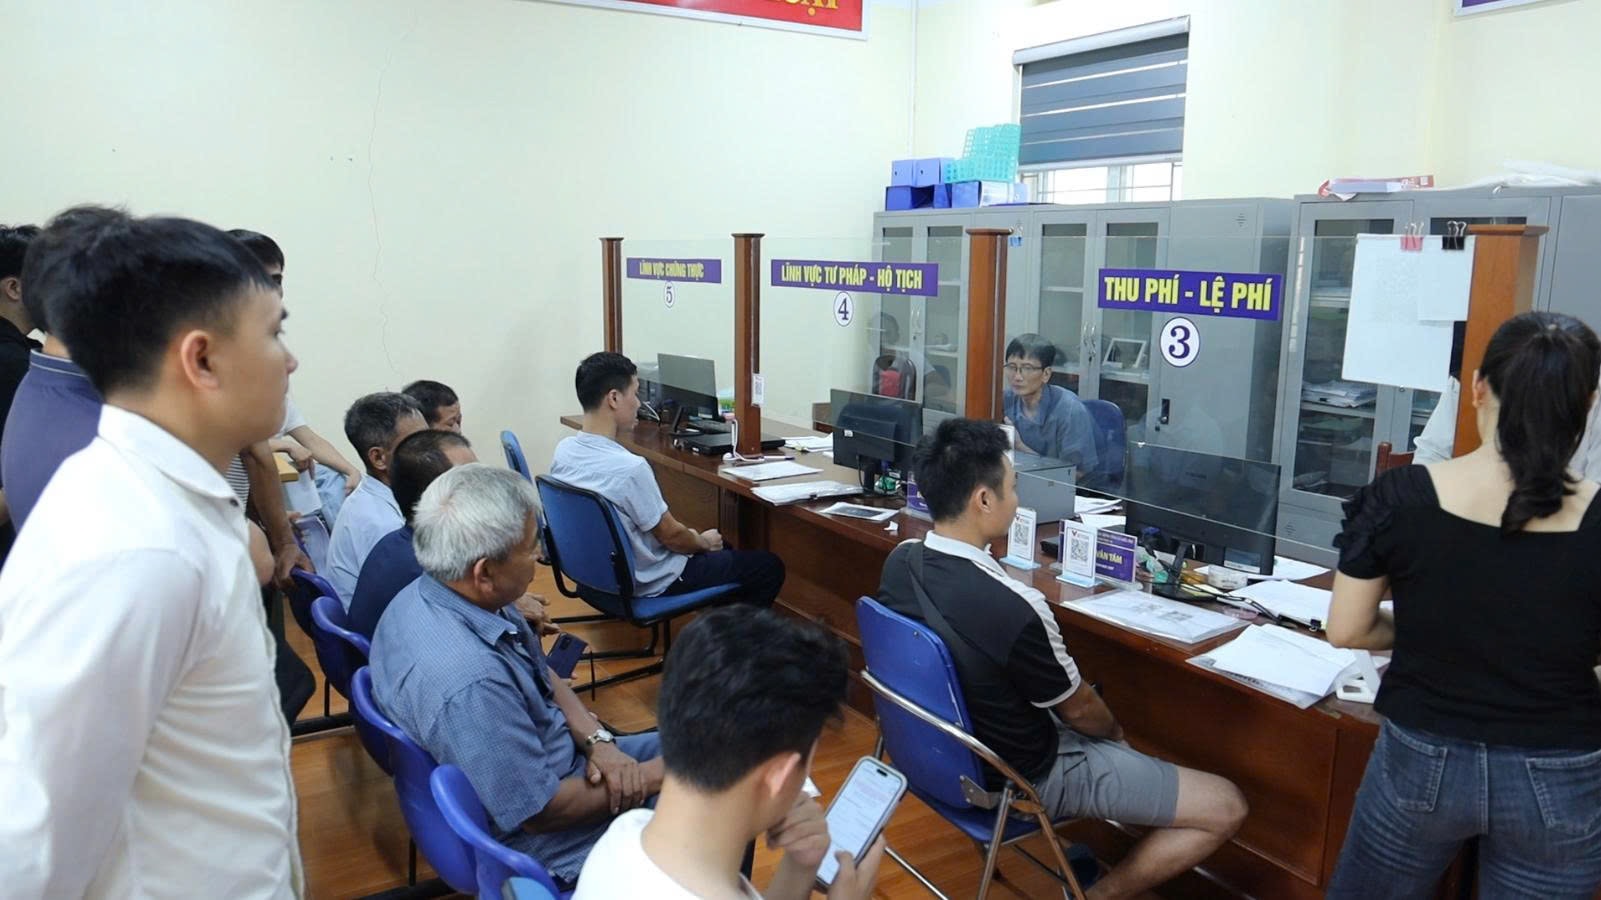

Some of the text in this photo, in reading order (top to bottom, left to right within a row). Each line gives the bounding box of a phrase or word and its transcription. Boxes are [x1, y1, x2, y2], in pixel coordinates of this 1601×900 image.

[781, 262, 801, 282] LĨNH
[803, 264, 822, 287] VỰC
[824, 265, 839, 284] TƯ
[839, 264, 867, 286] PHÁP
[877, 265, 893, 292] HỘ
[895, 268, 922, 293] TỊCH
[665, 285, 673, 304] 5
[837, 297, 850, 321] 4
[1104, 276, 1140, 302] THU
[1145, 274, 1180, 304] PHÍ
[1199, 275, 1225, 313] LỆ
[1231, 278, 1273, 311] PHÍ
[1168, 325, 1191, 359] 3
